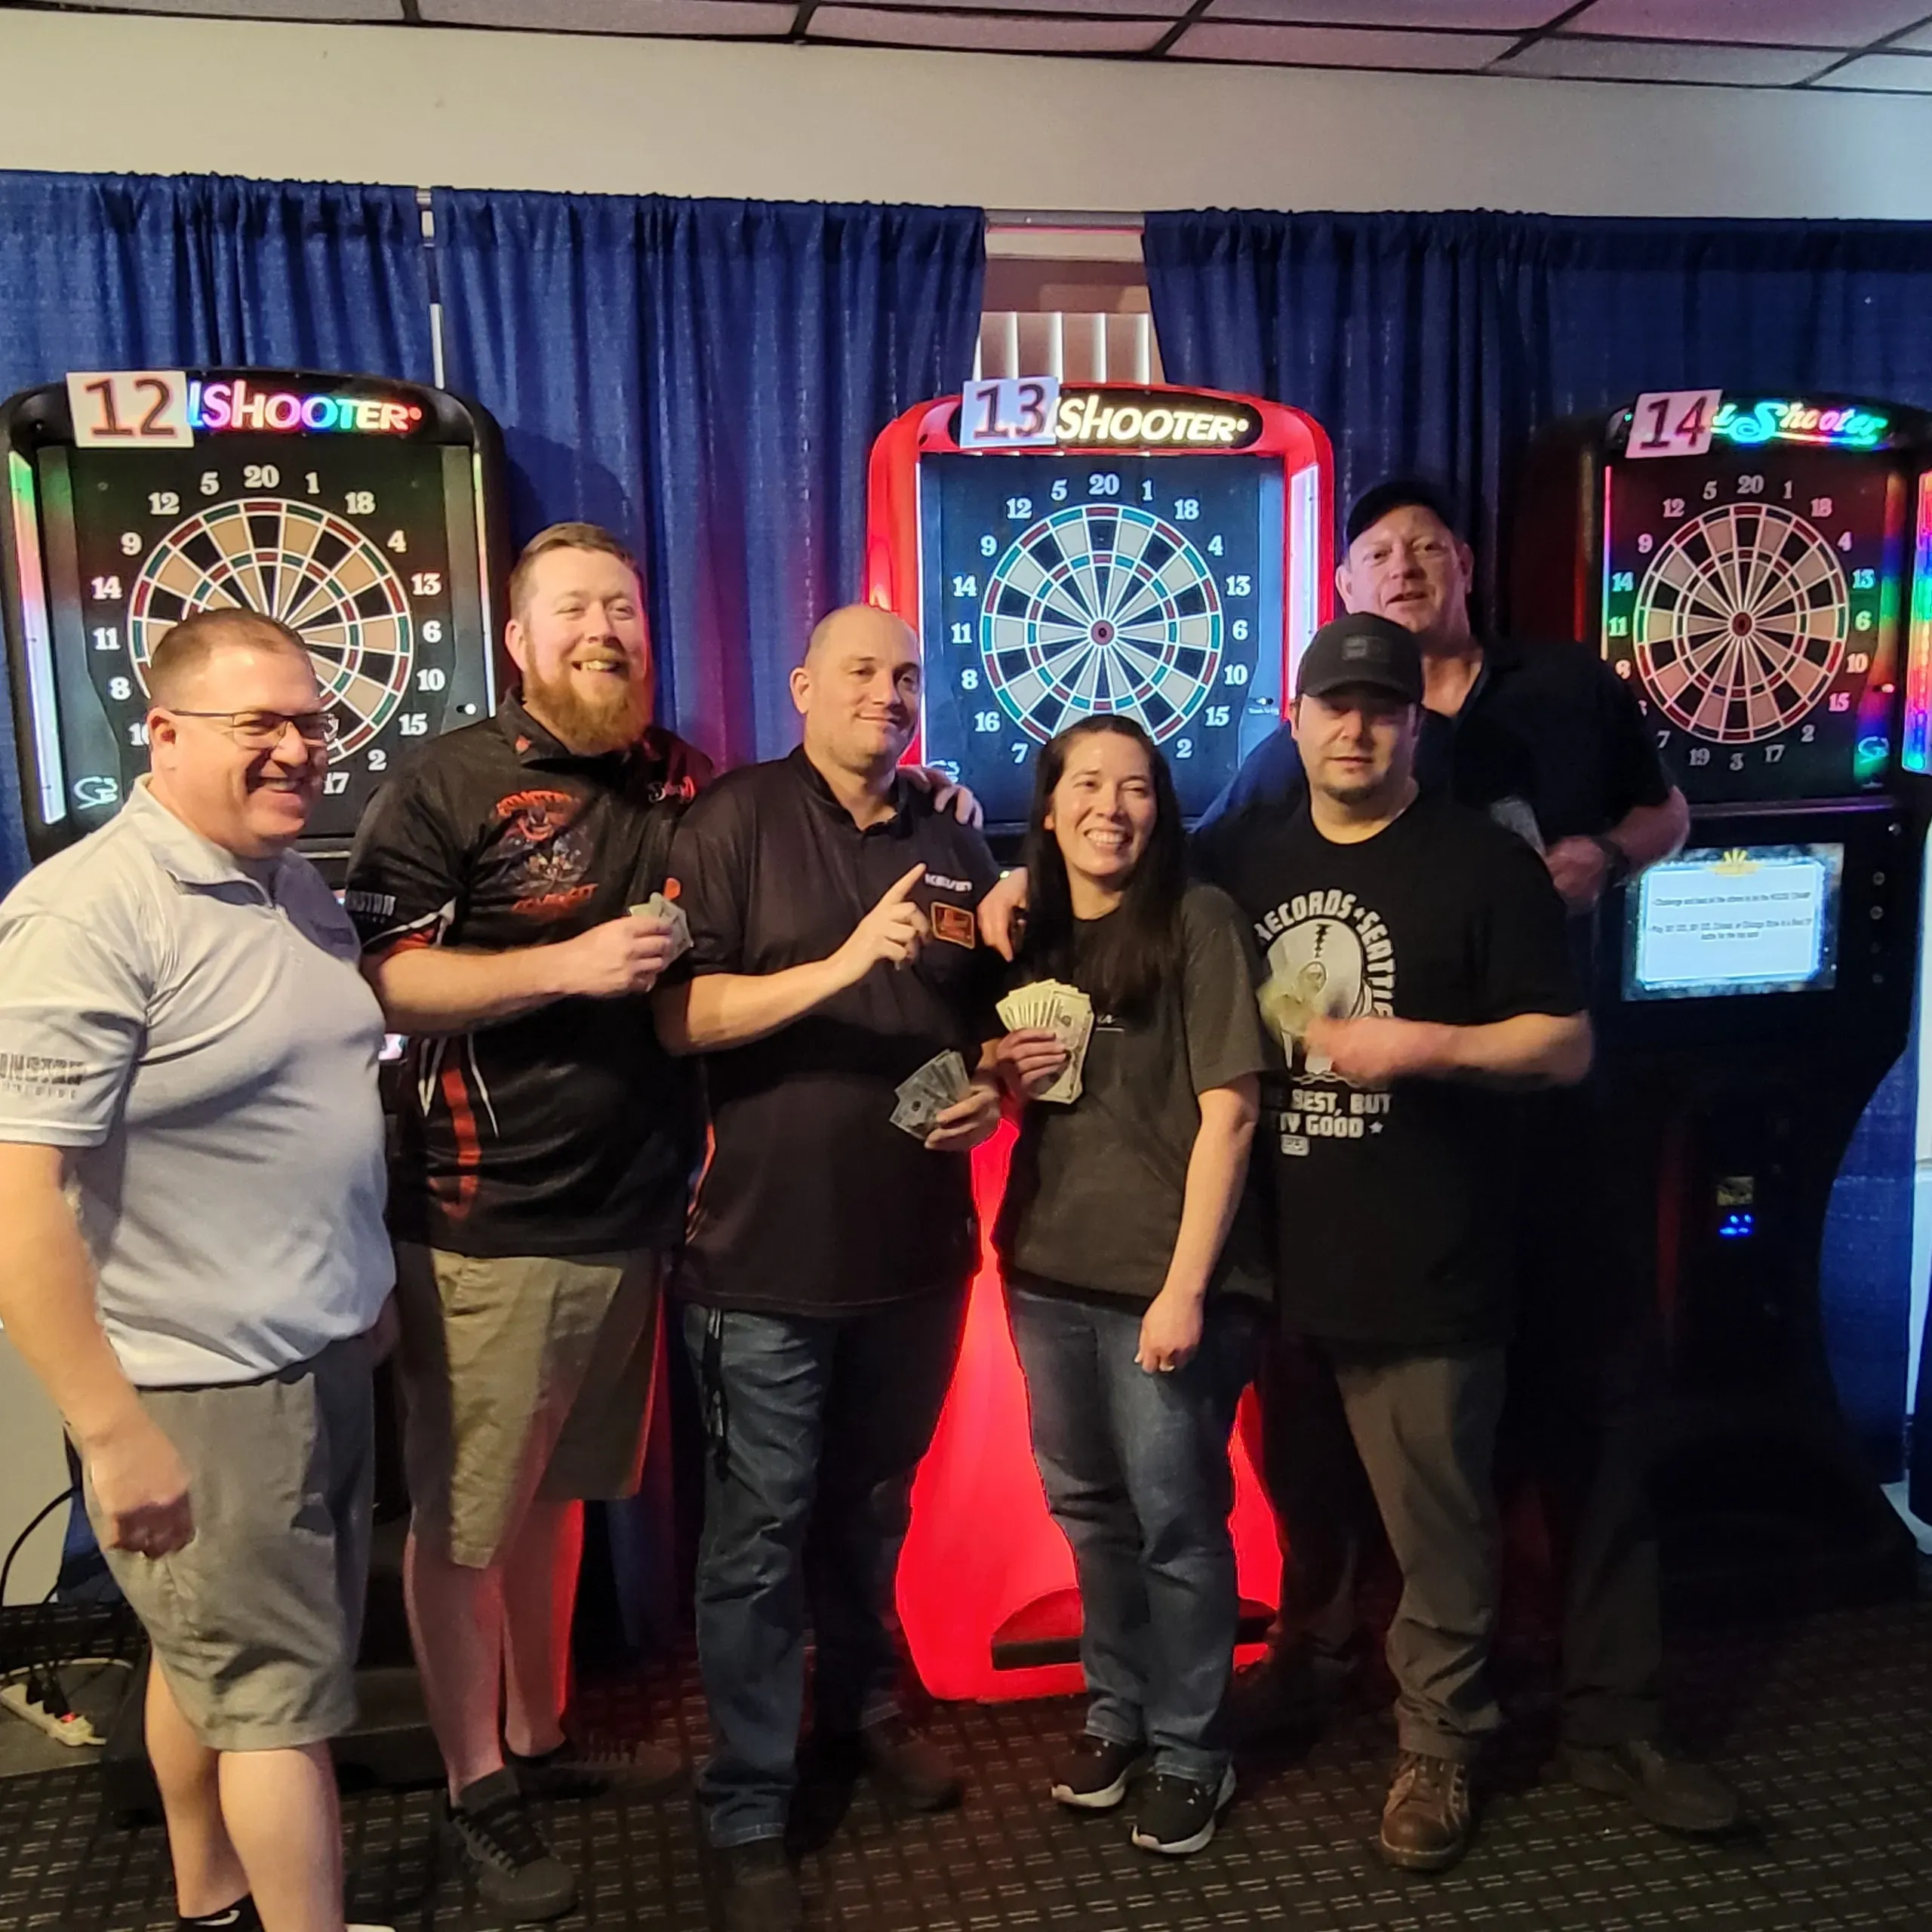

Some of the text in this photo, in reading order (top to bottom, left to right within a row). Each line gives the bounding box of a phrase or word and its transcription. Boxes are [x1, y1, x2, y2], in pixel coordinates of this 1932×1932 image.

[85, 379, 175, 437] 12
[974, 383, 1047, 440] 13
[1057, 394, 1242, 442] SHOOTER
[1639, 397, 1708, 451] 14
[201, 472, 219, 494] 5
[244, 465, 279, 488] 20
[306, 472, 319, 494] 1
[1089, 474, 1119, 494] 20
[1737, 475, 1764, 494] 20
[1051, 480, 1066, 500] 5
[1143, 481, 1152, 500] 1
[1703, 481, 1716, 500] 5
[1784, 481, 1792, 499] 1
[149, 493, 179, 514] 12
[346, 492, 375, 514] 18
[1007, 498, 1032, 518] 12
[1175, 500, 1198, 519] 18
[1663, 499, 1684, 517] 12
[122, 533, 141, 555] 9
[388, 531, 406, 552] 4
[981, 535, 996, 555] 9
[1208, 536, 1223, 555] 4
[1638, 534, 1652, 552] 9
[1838, 532, 1851, 550] 4
[92, 577, 122, 599] 14
[411, 573, 441, 595] 13
[953, 576, 977, 596] 14
[1226, 575, 1251, 595] 13
[1613, 572, 1632, 592] 14
[1233, 620, 1247, 640] 6
[1609, 617, 1627, 636] 11
[1856, 611, 1871, 630] 6
[94, 628, 120, 650] 11
[423, 620, 441, 642] 6
[952, 623, 972, 643] 11
[1847, 654, 1868, 672] 10
[417, 669, 445, 691] 10
[961, 669, 978, 689] 8
[1225, 664, 1247, 685] 10
[110, 677, 131, 700] 8
[1829, 693, 1850, 711] 15
[399, 713, 427, 734] 15
[975, 712, 1000, 731] 16
[1206, 706, 1229, 726] 15
[1658, 731, 1670, 748] 7
[1801, 725, 1814, 742] 2
[1012, 743, 1028, 763] 7
[1177, 739, 1192, 758] 2
[1766, 745, 1784, 761] 17
[368, 749, 386, 770] 2
[324, 773, 349, 794] 17
[1350, 1094, 1392, 1115] BUT
[1306, 1115, 1364, 1138] GOOD
